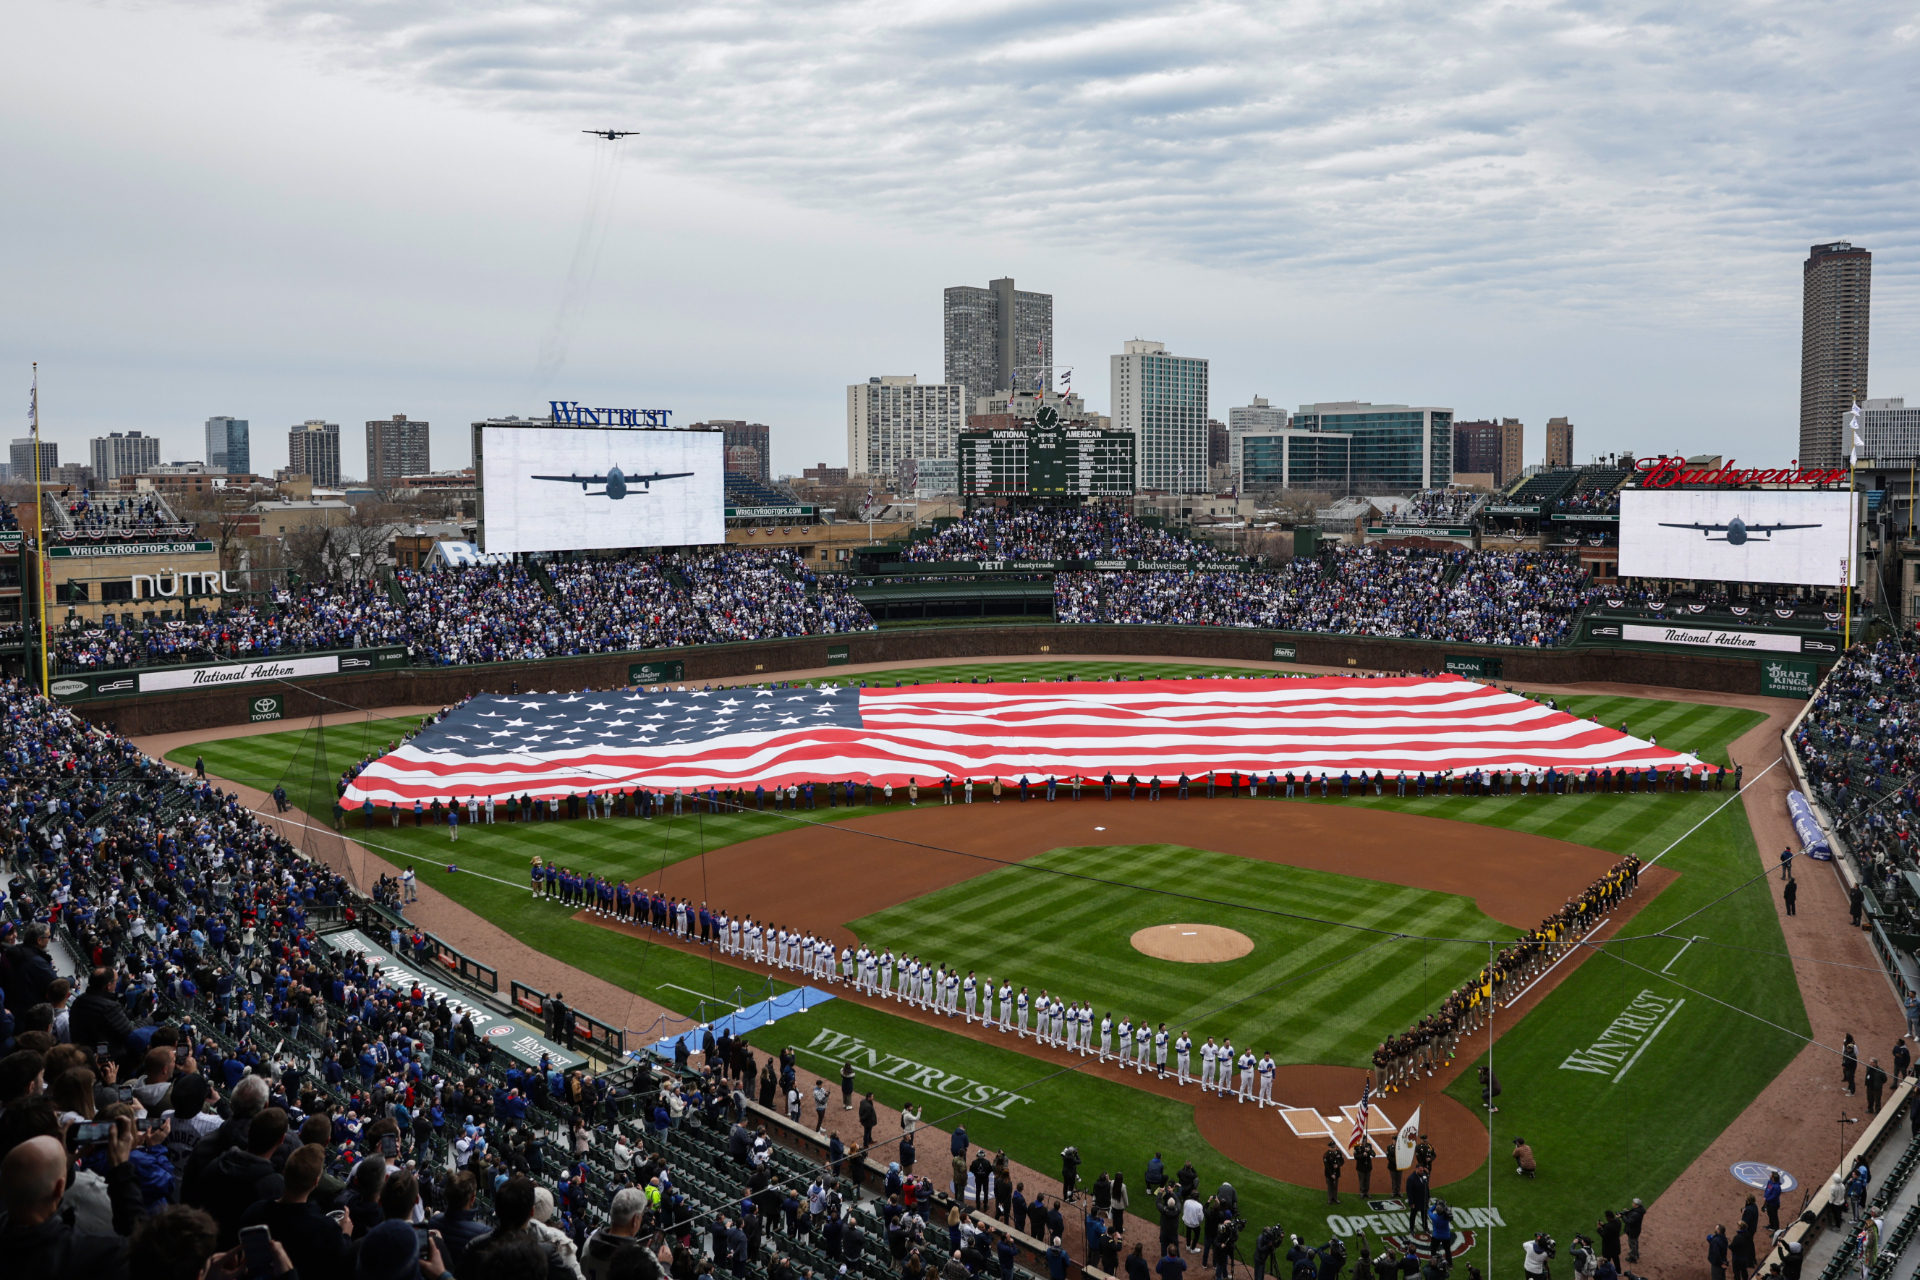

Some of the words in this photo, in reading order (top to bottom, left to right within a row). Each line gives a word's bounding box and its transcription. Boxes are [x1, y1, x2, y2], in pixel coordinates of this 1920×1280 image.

[550, 401, 673, 427] WINTRUST
[1635, 456, 1847, 488] Budweiser
[735, 508, 802, 516] WRIGLEYROOFTOPS.COM
[1386, 528, 1449, 536] WRIGLEYROOFTOPS.COM
[69, 543, 196, 556] WRIGLEYROOFTOPS.COM
[977, 561, 1004, 570] YETI
[1137, 561, 1187, 569] Budweiser
[1664, 629, 1712, 644] National
[1715, 633, 1757, 647] Anthem
[1275, 648, 1295, 657] Hefty
[1446, 662, 1480, 670] SLOAN
[193, 665, 248, 684] National
[251, 664, 295, 679] Anthem
[632, 671, 660, 679] Gallagher
[1769, 669, 1810, 679] DRAFT
[1773, 677, 1808, 686] KINGS
[53, 683, 84, 691] HORNITOS
[1769, 684, 1810, 692] SPORTSBOO
[252, 712, 281, 721] TOYOTA
[1558, 988, 1674, 1075] WINTRUST
[518, 1035, 572, 1066] WINTRUST
[806, 1027, 1035, 1112] WINTRUST
[1452, 1206, 1507, 1228] DAY
